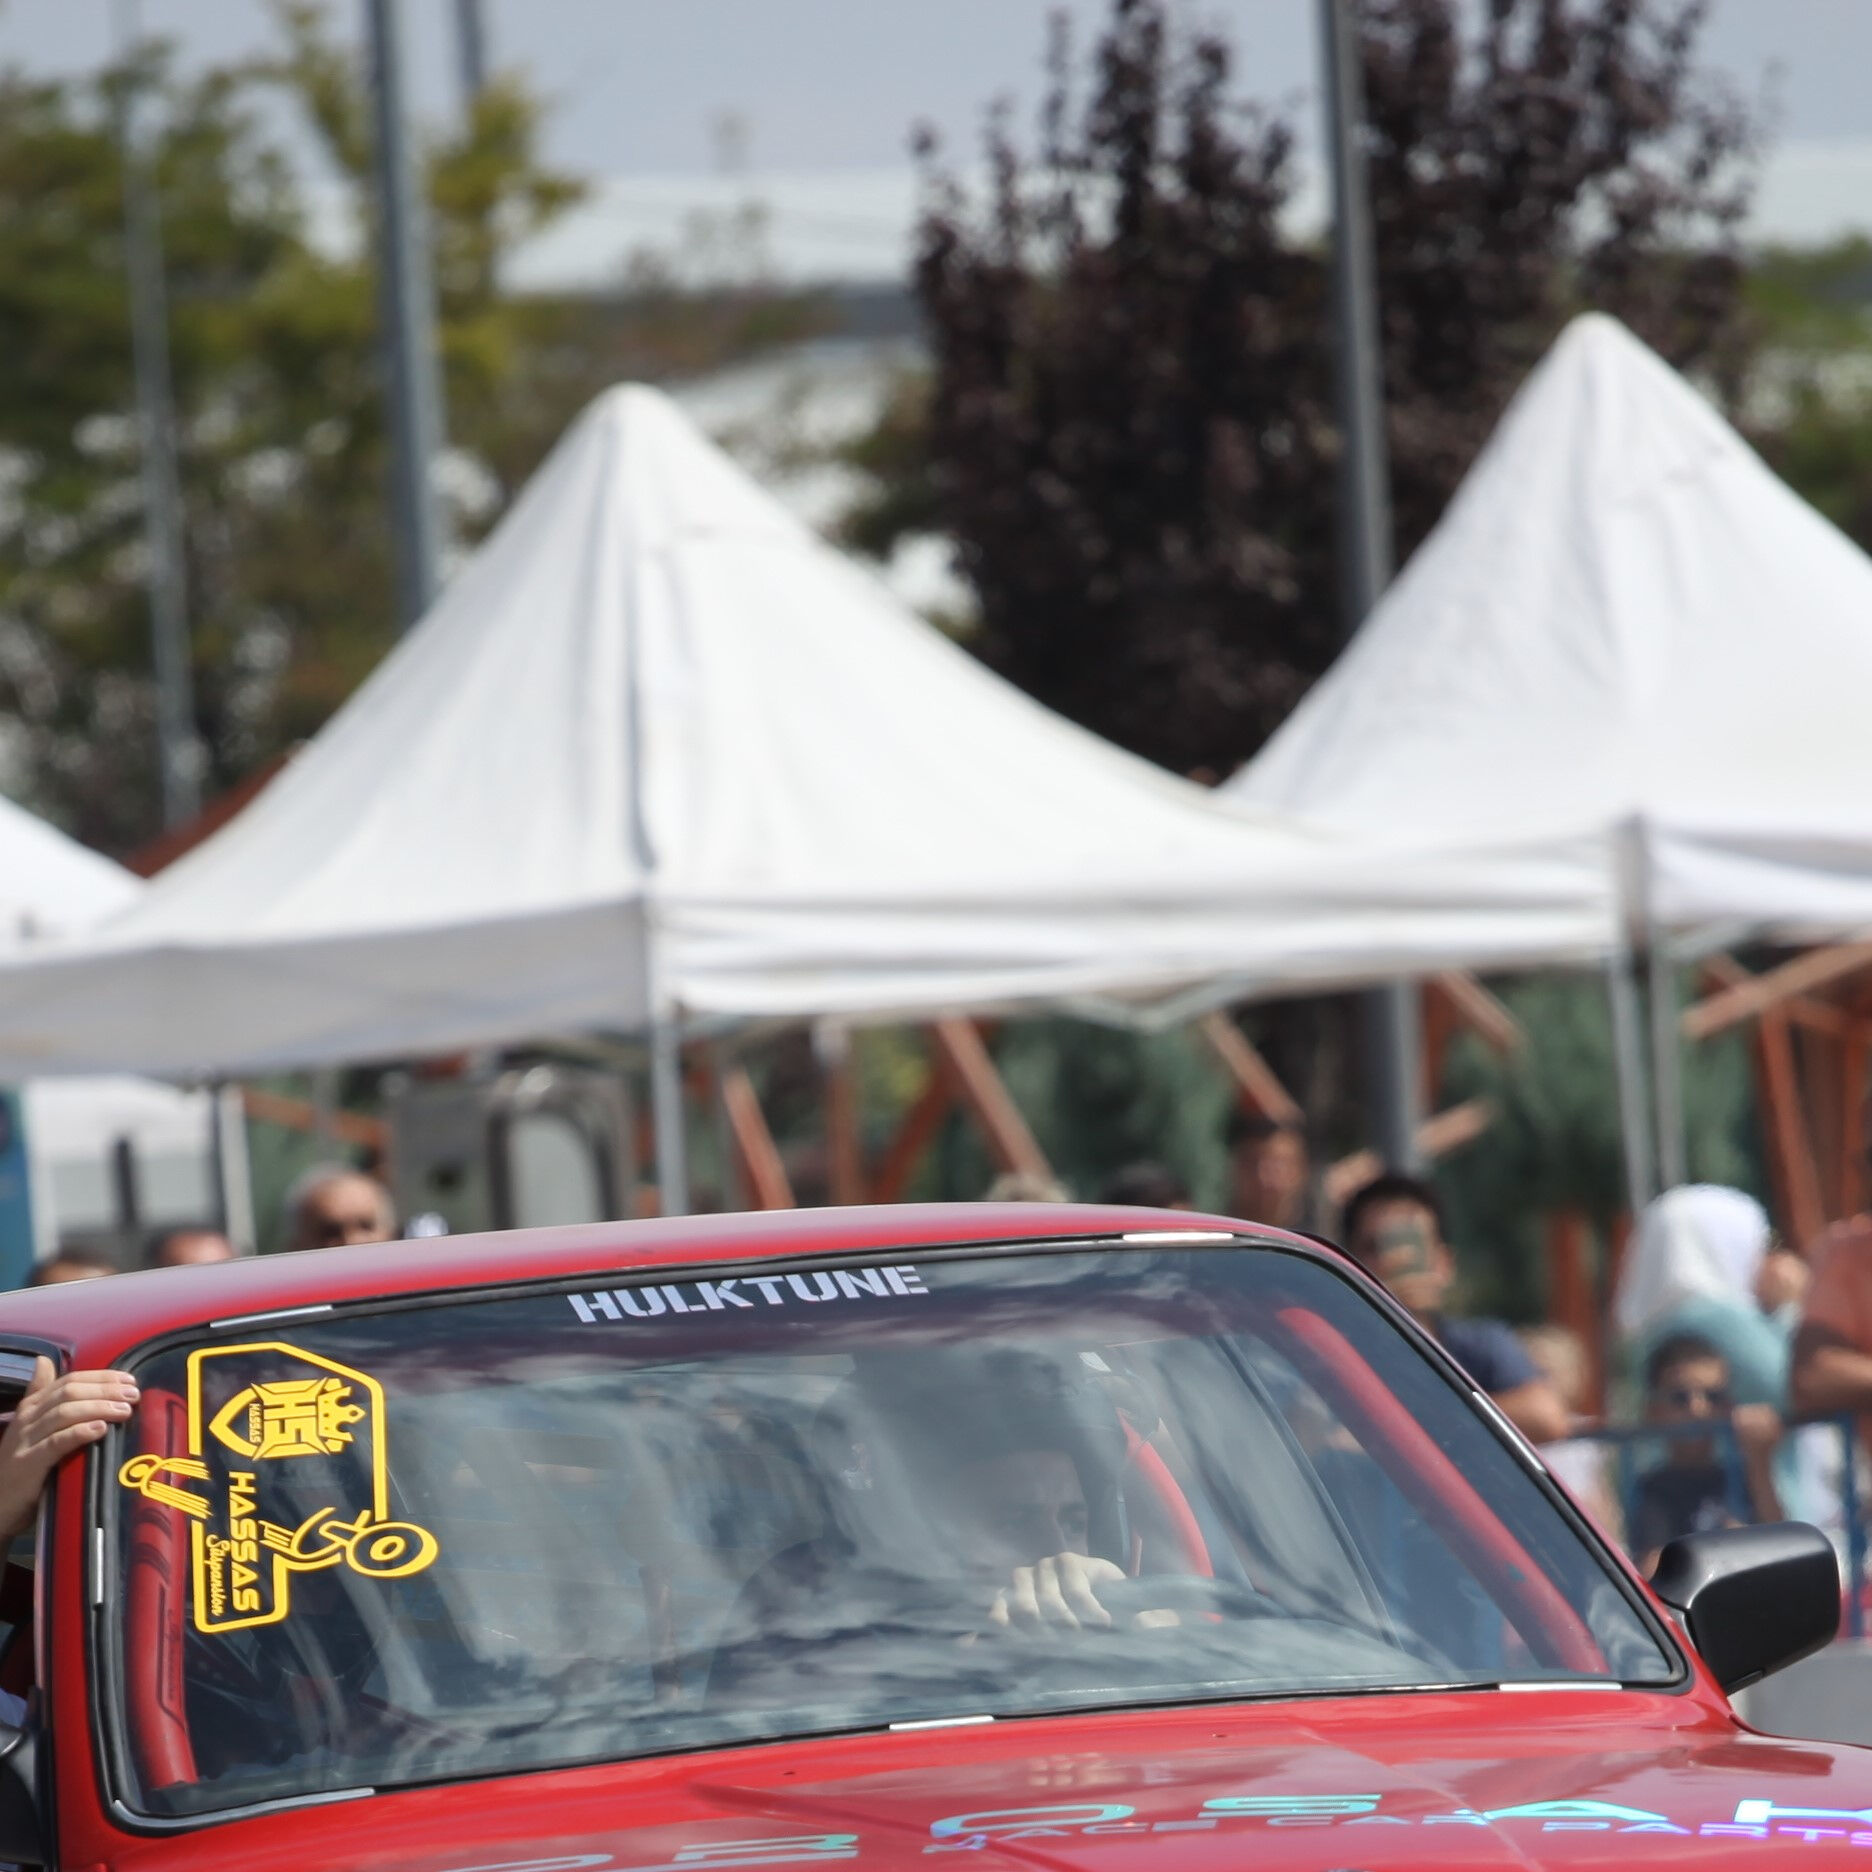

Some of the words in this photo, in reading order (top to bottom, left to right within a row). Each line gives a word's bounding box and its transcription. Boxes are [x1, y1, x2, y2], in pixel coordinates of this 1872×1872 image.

[566, 1264, 930, 1324] HULKTUNE
[248, 1402, 262, 1444] HASSAS
[228, 1470, 260, 1612] HASSAS
